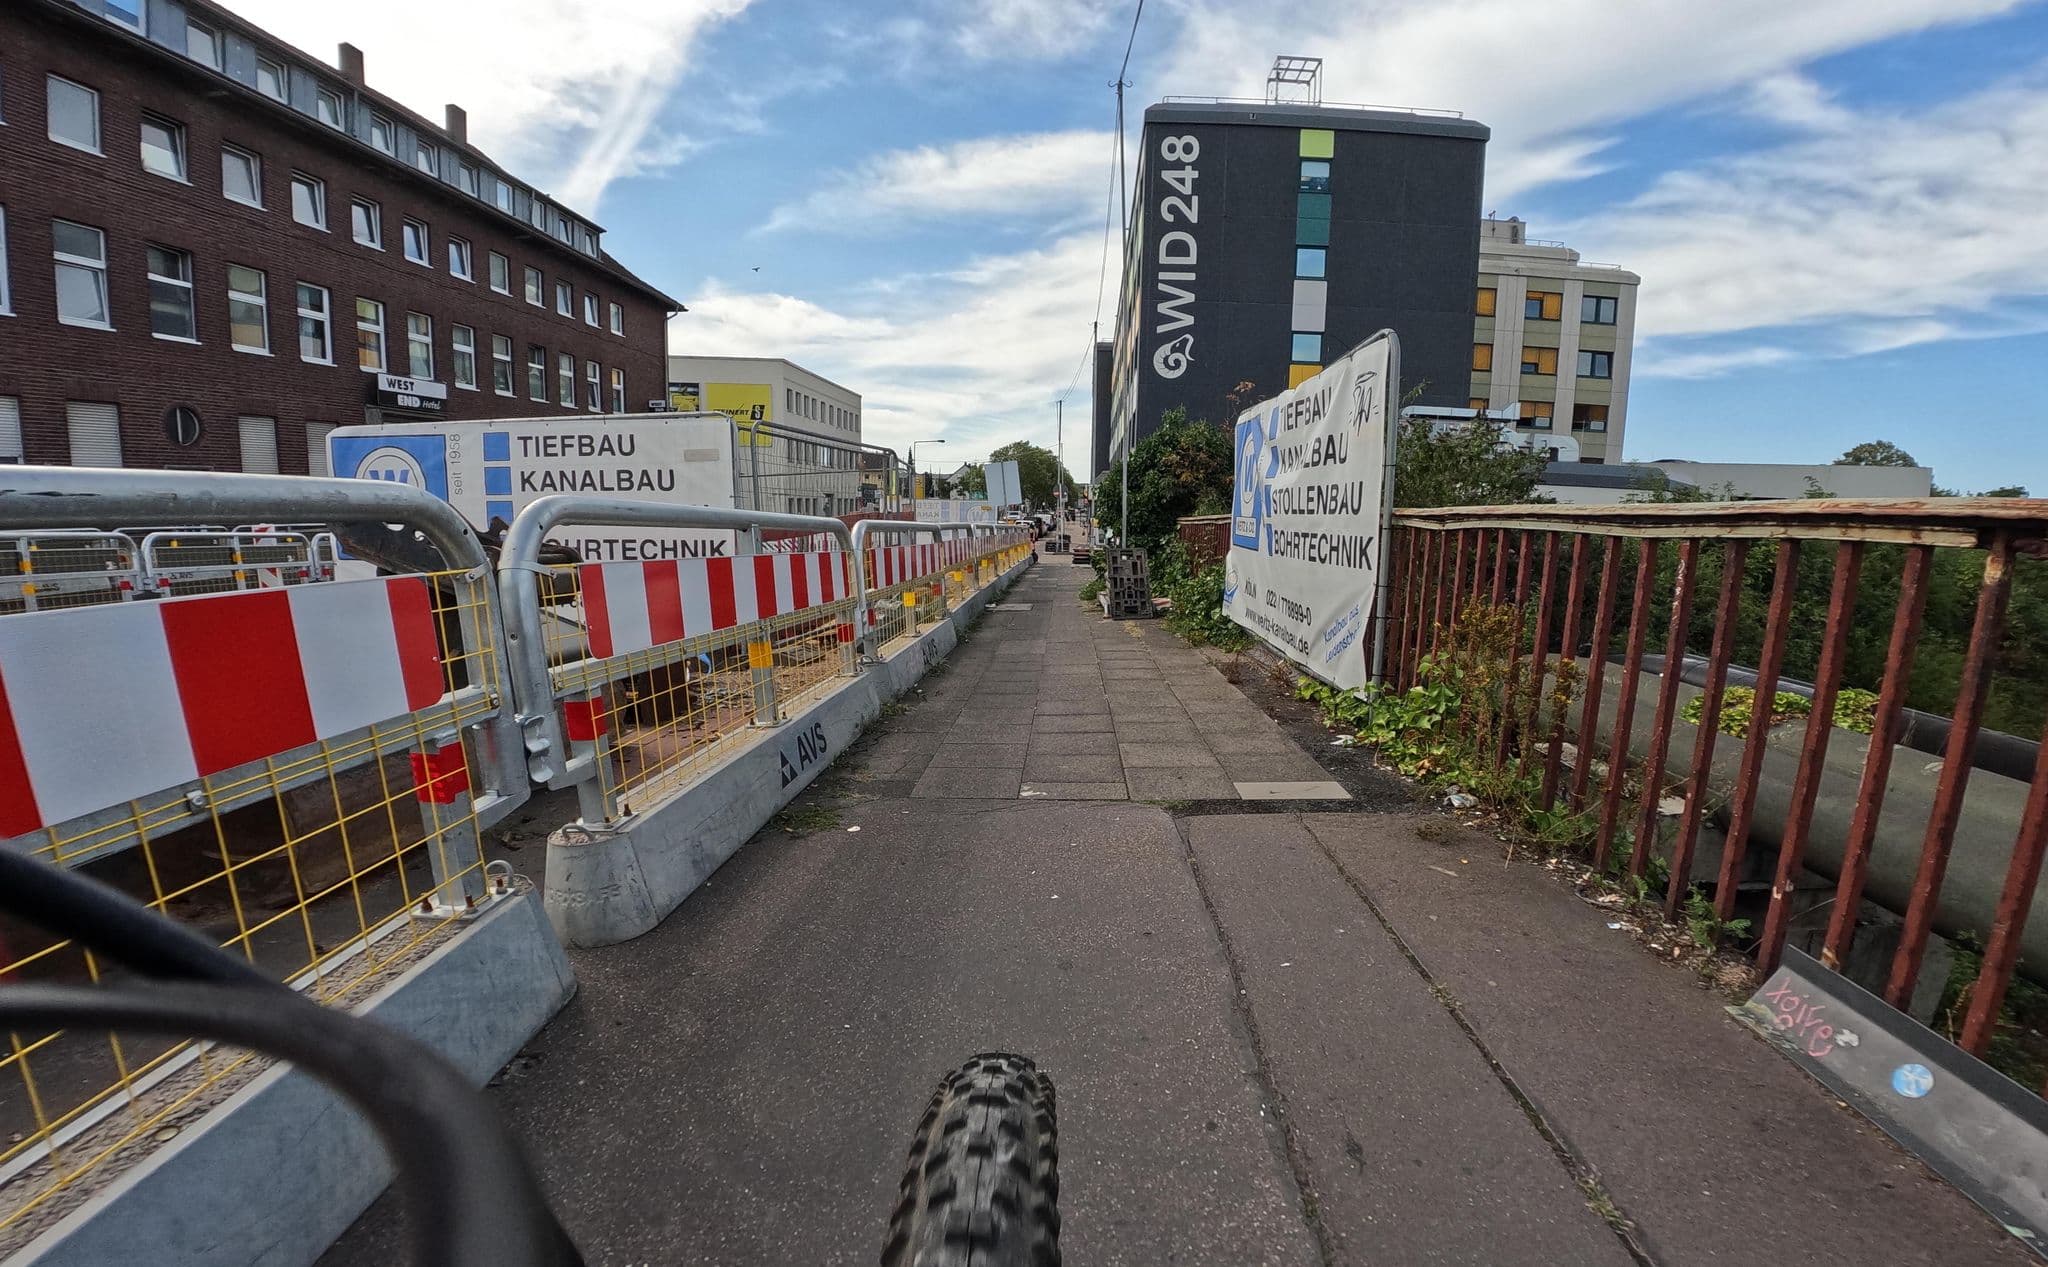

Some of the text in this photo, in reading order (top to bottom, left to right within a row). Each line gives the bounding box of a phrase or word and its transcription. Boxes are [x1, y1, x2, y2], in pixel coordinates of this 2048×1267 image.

[1156, 134, 1200, 334] WID 248
[386, 378, 415, 391] WEST
[397, 394, 441, 410] END Hotel
[1280, 386, 1332, 433] IEFBAU
[517, 433, 636, 458] TIEFBAU
[449, 433, 463, 496] seit 1958
[520, 468, 676, 493] KANALBAU
[1272, 481, 1363, 516] STOLLENBAU
[545, 538, 727, 561] HRTECHNIK
[1274, 530, 1374, 571] BOHRTECHNIK
[796, 721, 828, 772] AVS
